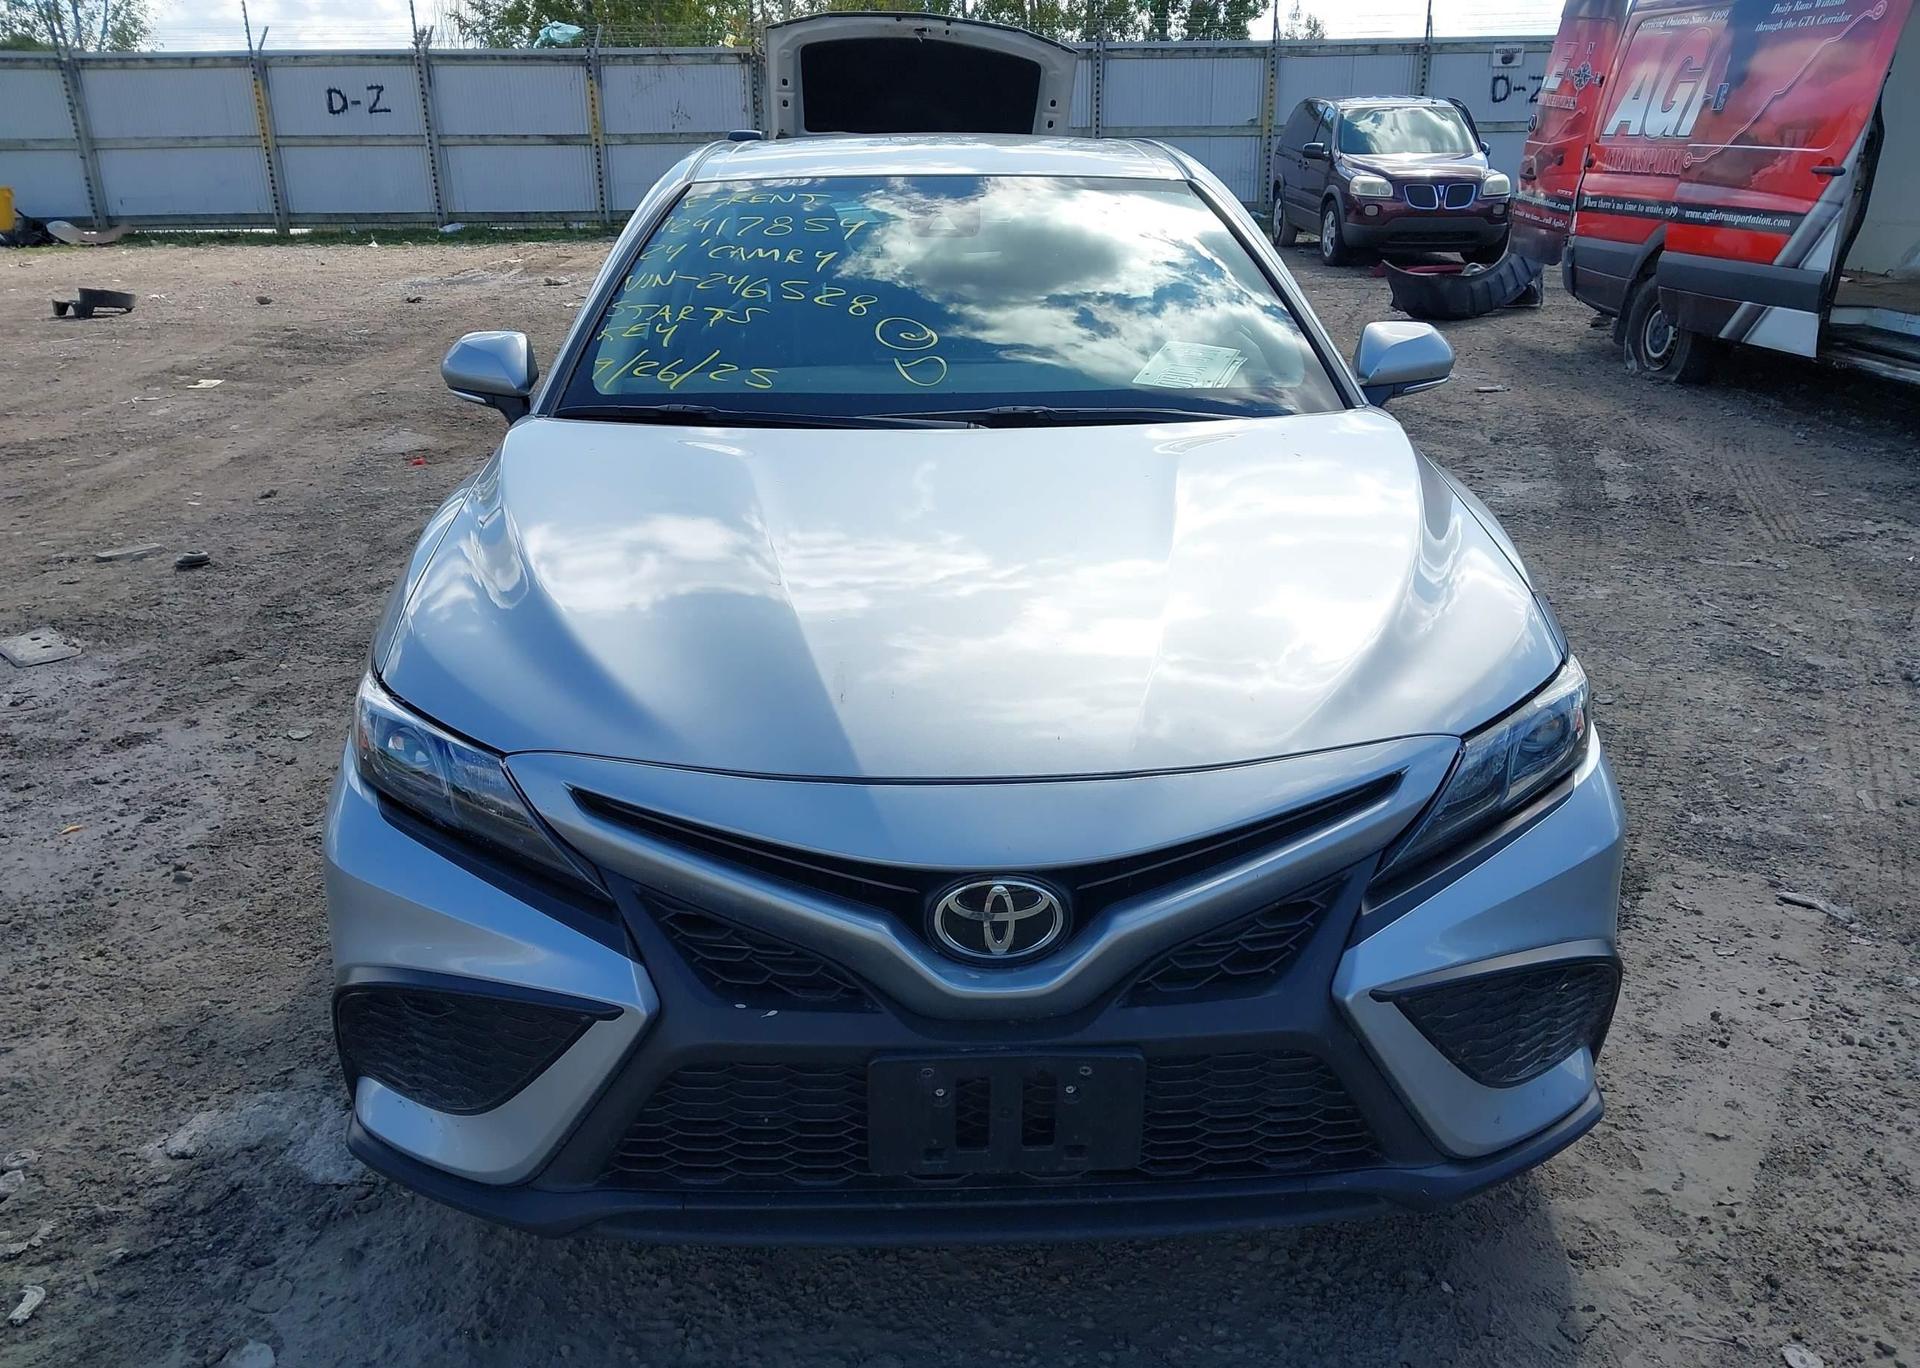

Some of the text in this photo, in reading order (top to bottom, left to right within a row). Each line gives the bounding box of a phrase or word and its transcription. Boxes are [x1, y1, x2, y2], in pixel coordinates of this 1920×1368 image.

[1816, 11, 1853, 25] Corridor
[326, 84, 392, 115] D-Z
[1684, 208, 1791, 228] www.agiletransportation.com
